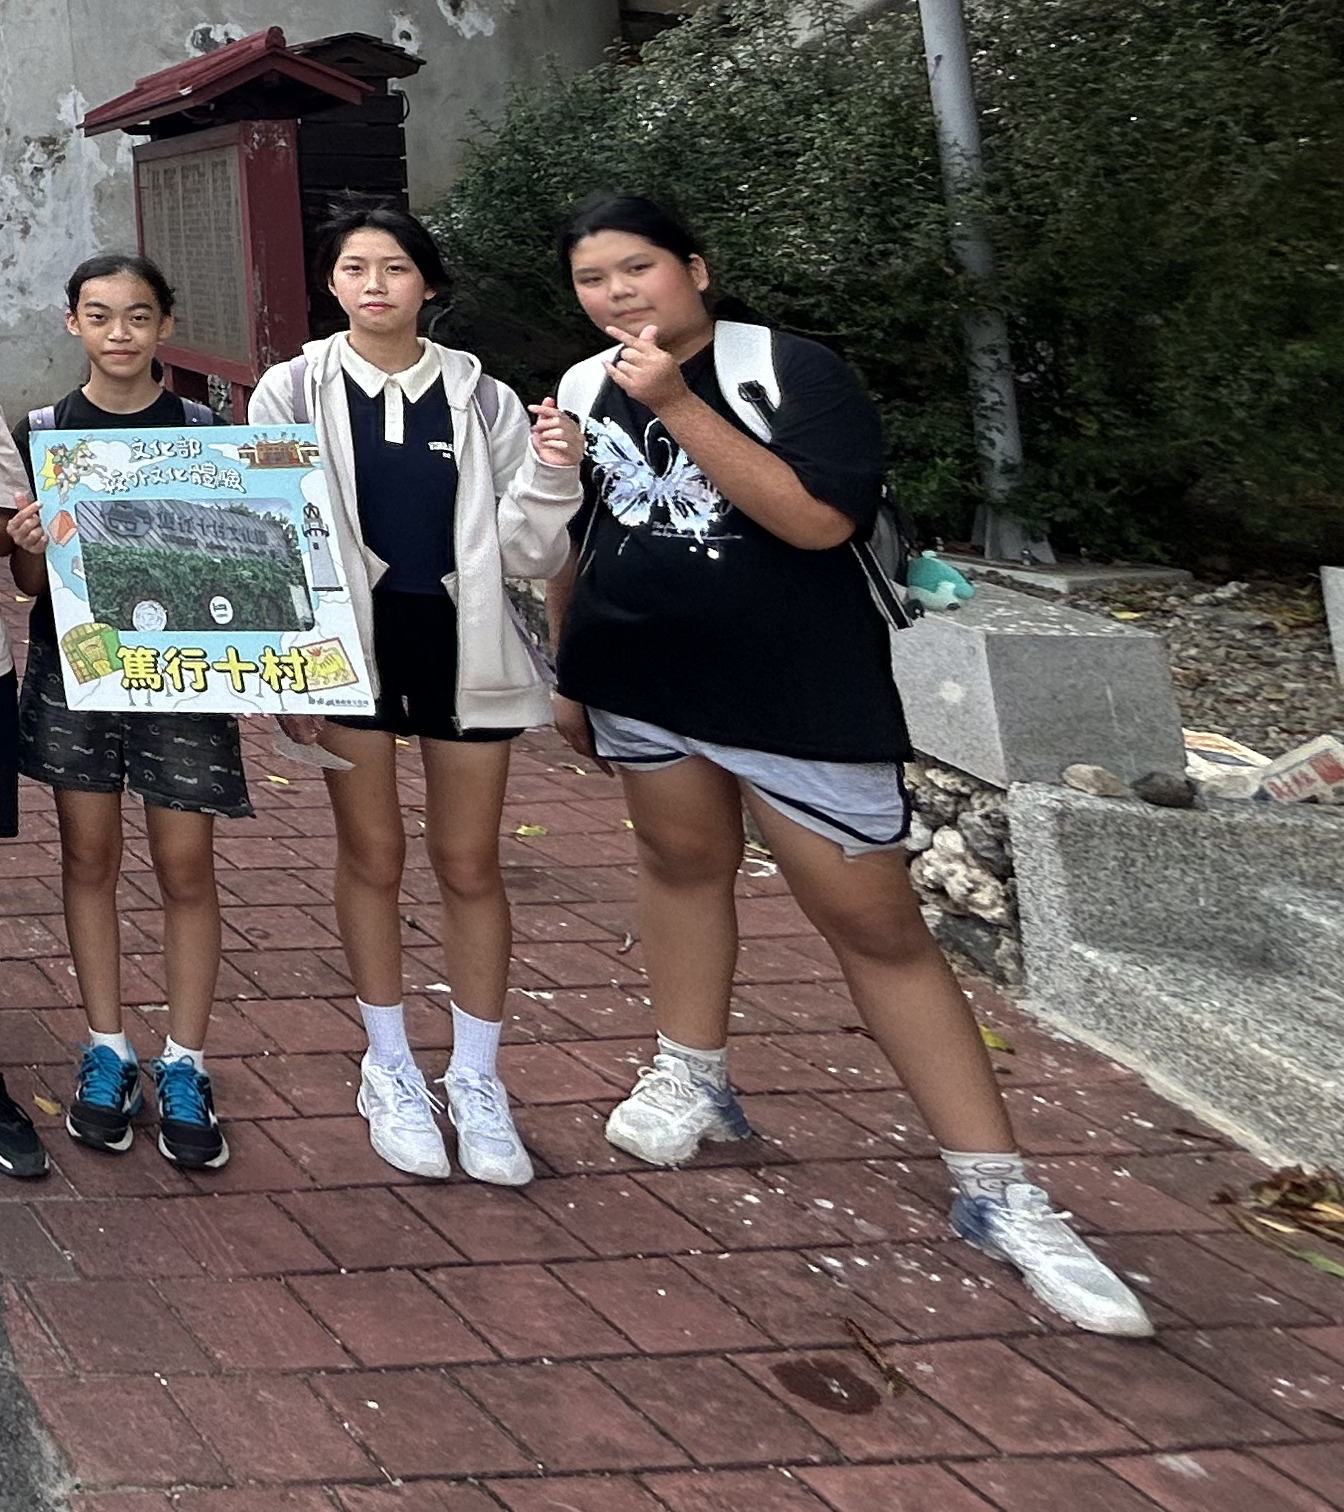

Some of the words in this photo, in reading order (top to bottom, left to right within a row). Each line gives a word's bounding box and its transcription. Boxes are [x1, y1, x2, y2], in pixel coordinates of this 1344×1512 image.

[130, 435, 203, 460] 文化部
[116, 645, 309, 693] 篤行十村
